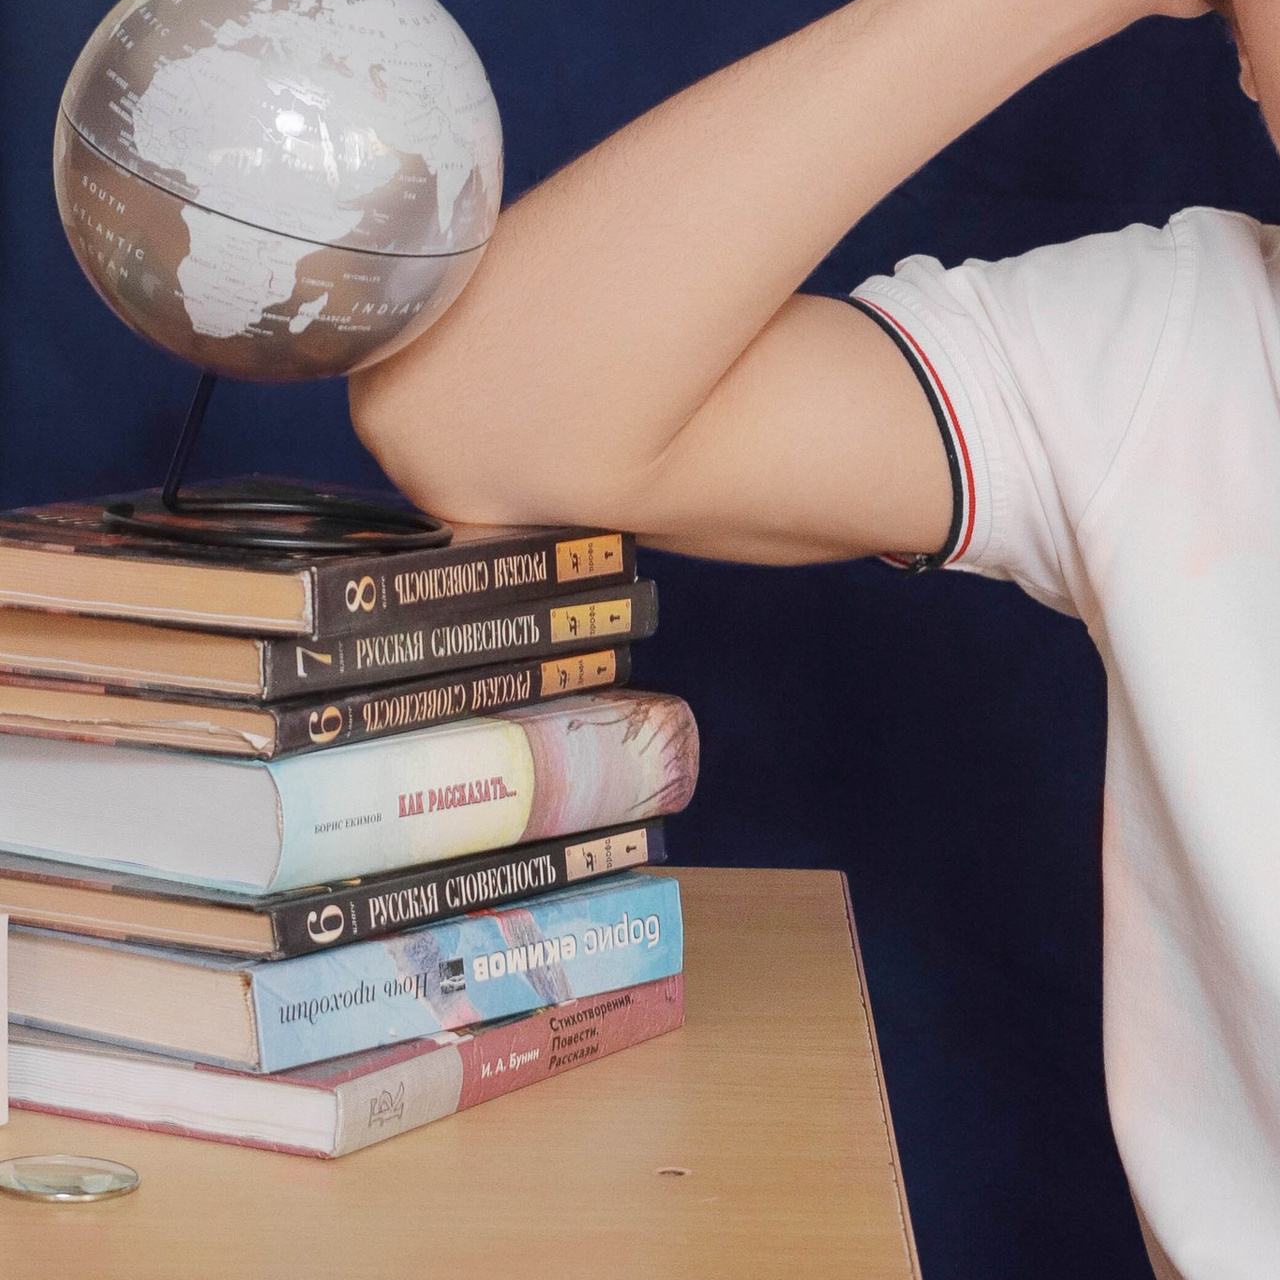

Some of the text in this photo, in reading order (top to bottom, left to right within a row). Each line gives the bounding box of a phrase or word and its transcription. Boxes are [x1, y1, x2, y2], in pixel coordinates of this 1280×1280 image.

[81, 175, 127, 216] SOUTH
[72, 203, 145, 261] ATLANTIC
[351, 301, 424, 316] INDIAN
[345, 575, 376, 613] 8
[394, 551, 547, 605] РУССКАЯ СЛОВЕСНОСТЬ
[296, 646, 332, 678] 7
[355, 614, 541, 670] РУССКАЯ СЛОВЕСНОСТЬ
[363, 670, 532, 733] РУССКАЯ СЛОВЕСНОСТЬ
[309, 706, 343, 743] 6
[399, 776, 518, 818] КАК РАССКАЗАТЬ...
[314, 812, 382, 834] БОРИС ЕКИМОВ
[368, 854, 557, 928] РУССКАЯ СЛОВЕСНОСТЬ
[307, 904, 345, 944] 6
[473, 913, 661, 982] борис екимов
[278, 972, 429, 1025] Ночь проходит
[481, 1048, 541, 1079] И. А. Бунин
[549, 1042, 601, 1071] Рассказы
